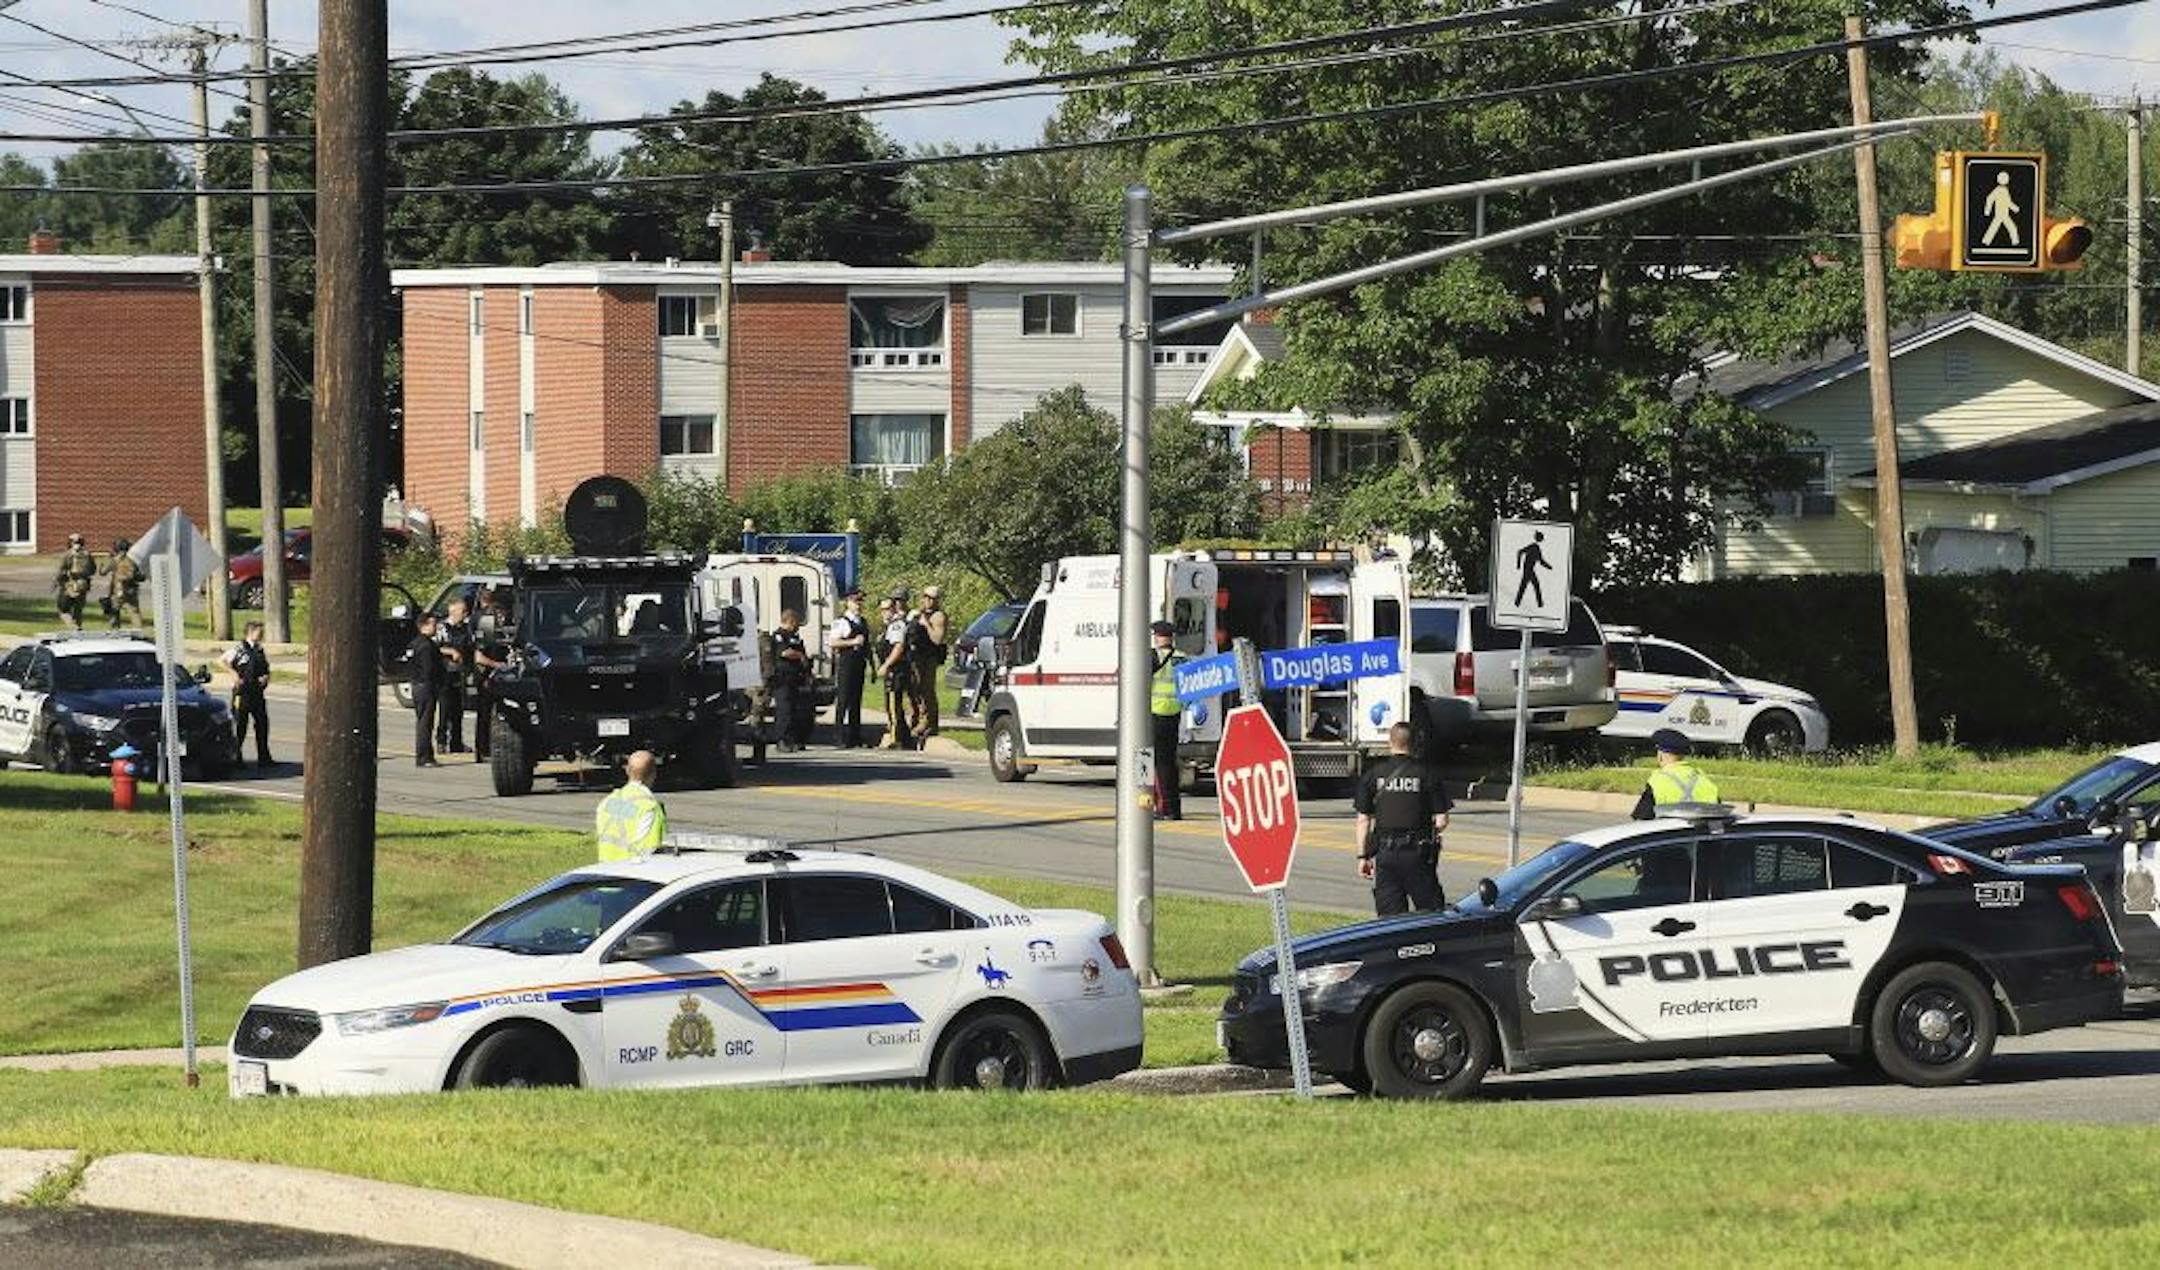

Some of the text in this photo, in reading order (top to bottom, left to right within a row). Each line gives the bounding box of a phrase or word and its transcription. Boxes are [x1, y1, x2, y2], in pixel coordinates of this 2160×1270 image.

[1271, 651, 1390, 682] Douglas Ave
[1177, 663, 1224, 696] Brookside
[1376, 777, 1421, 792] POLICE
[1222, 758, 1291, 836] STOP
[1598, 940, 1852, 987] POLICE
[482, 992, 545, 1008] POLICE
[1659, 997, 1759, 1018] Fredericton
[725, 1039, 754, 1056] GRC
[867, 1028, 921, 1047] Canada
[619, 1046, 659, 1064] RCMP
